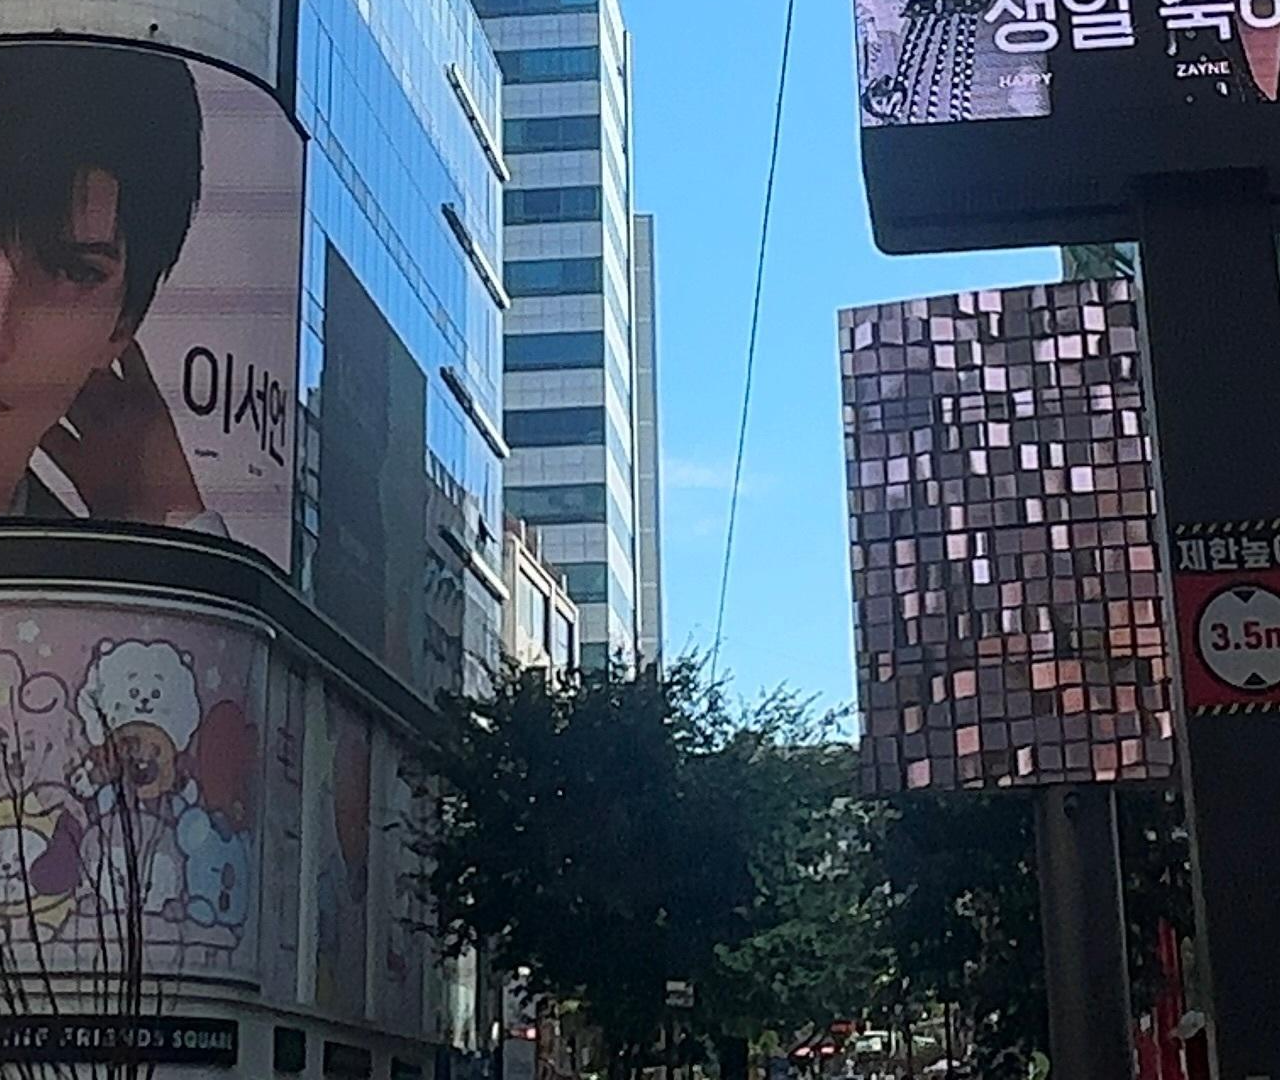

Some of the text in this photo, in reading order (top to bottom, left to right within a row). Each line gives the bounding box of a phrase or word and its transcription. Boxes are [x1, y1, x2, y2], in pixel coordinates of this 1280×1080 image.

[1000, 71, 1053, 88] HAPPY
[1176, 61, 1231, 78] ZAYNE
[183, 345, 287, 467] 이서언
